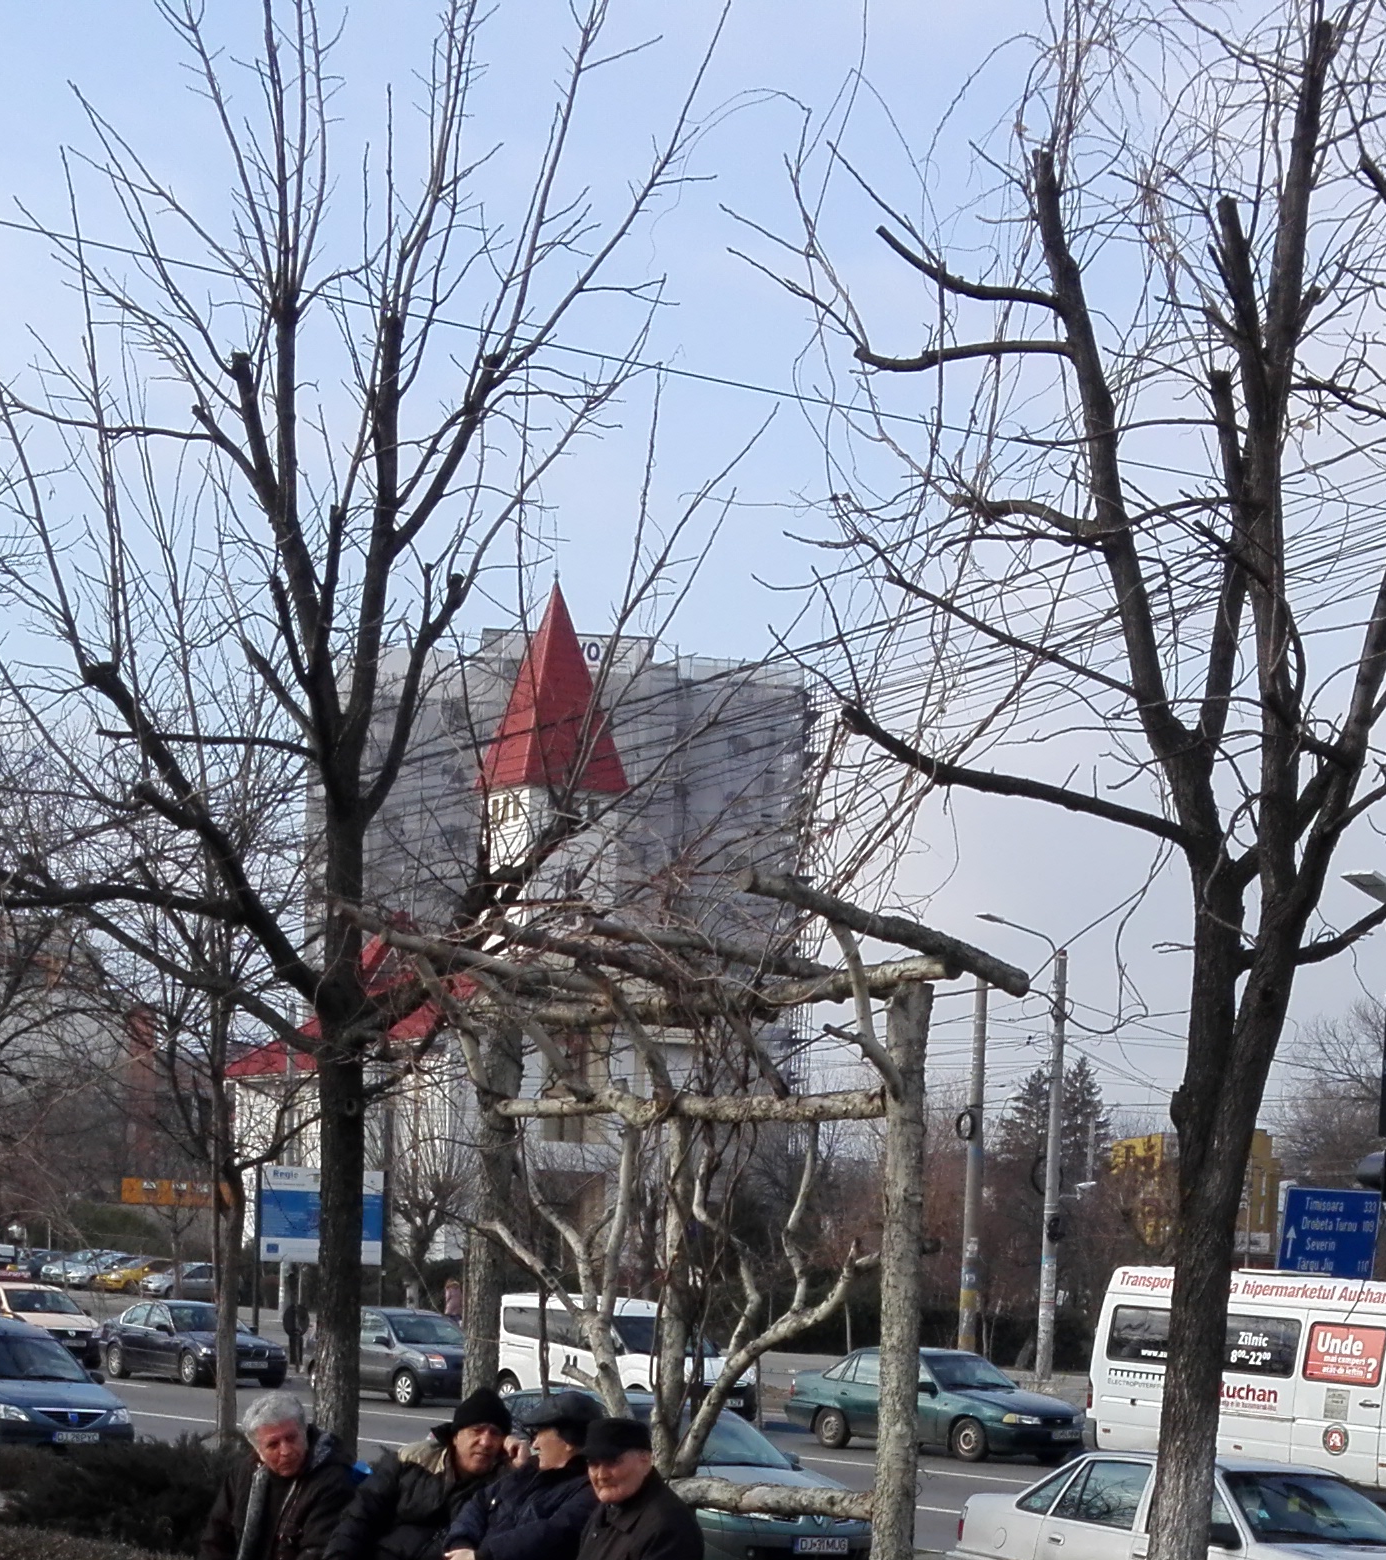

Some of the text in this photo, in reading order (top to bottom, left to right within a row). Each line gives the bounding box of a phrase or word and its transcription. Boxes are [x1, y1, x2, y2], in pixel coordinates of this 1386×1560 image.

[1363, 1201, 1377, 1213] 333
[1301, 1217, 1375, 1233] Drobeta Turnu 109
[1305, 1237, 1336, 1251] Severin
[1321, 1258, 1334, 1271] Jiu
[1119, 1271, 1175, 1290] Transpor
[1241, 1280, 1336, 1300] hipermarketul
[1238, 1331, 1269, 1347] Zilnic
[1317, 1331, 1364, 1356] Unde
